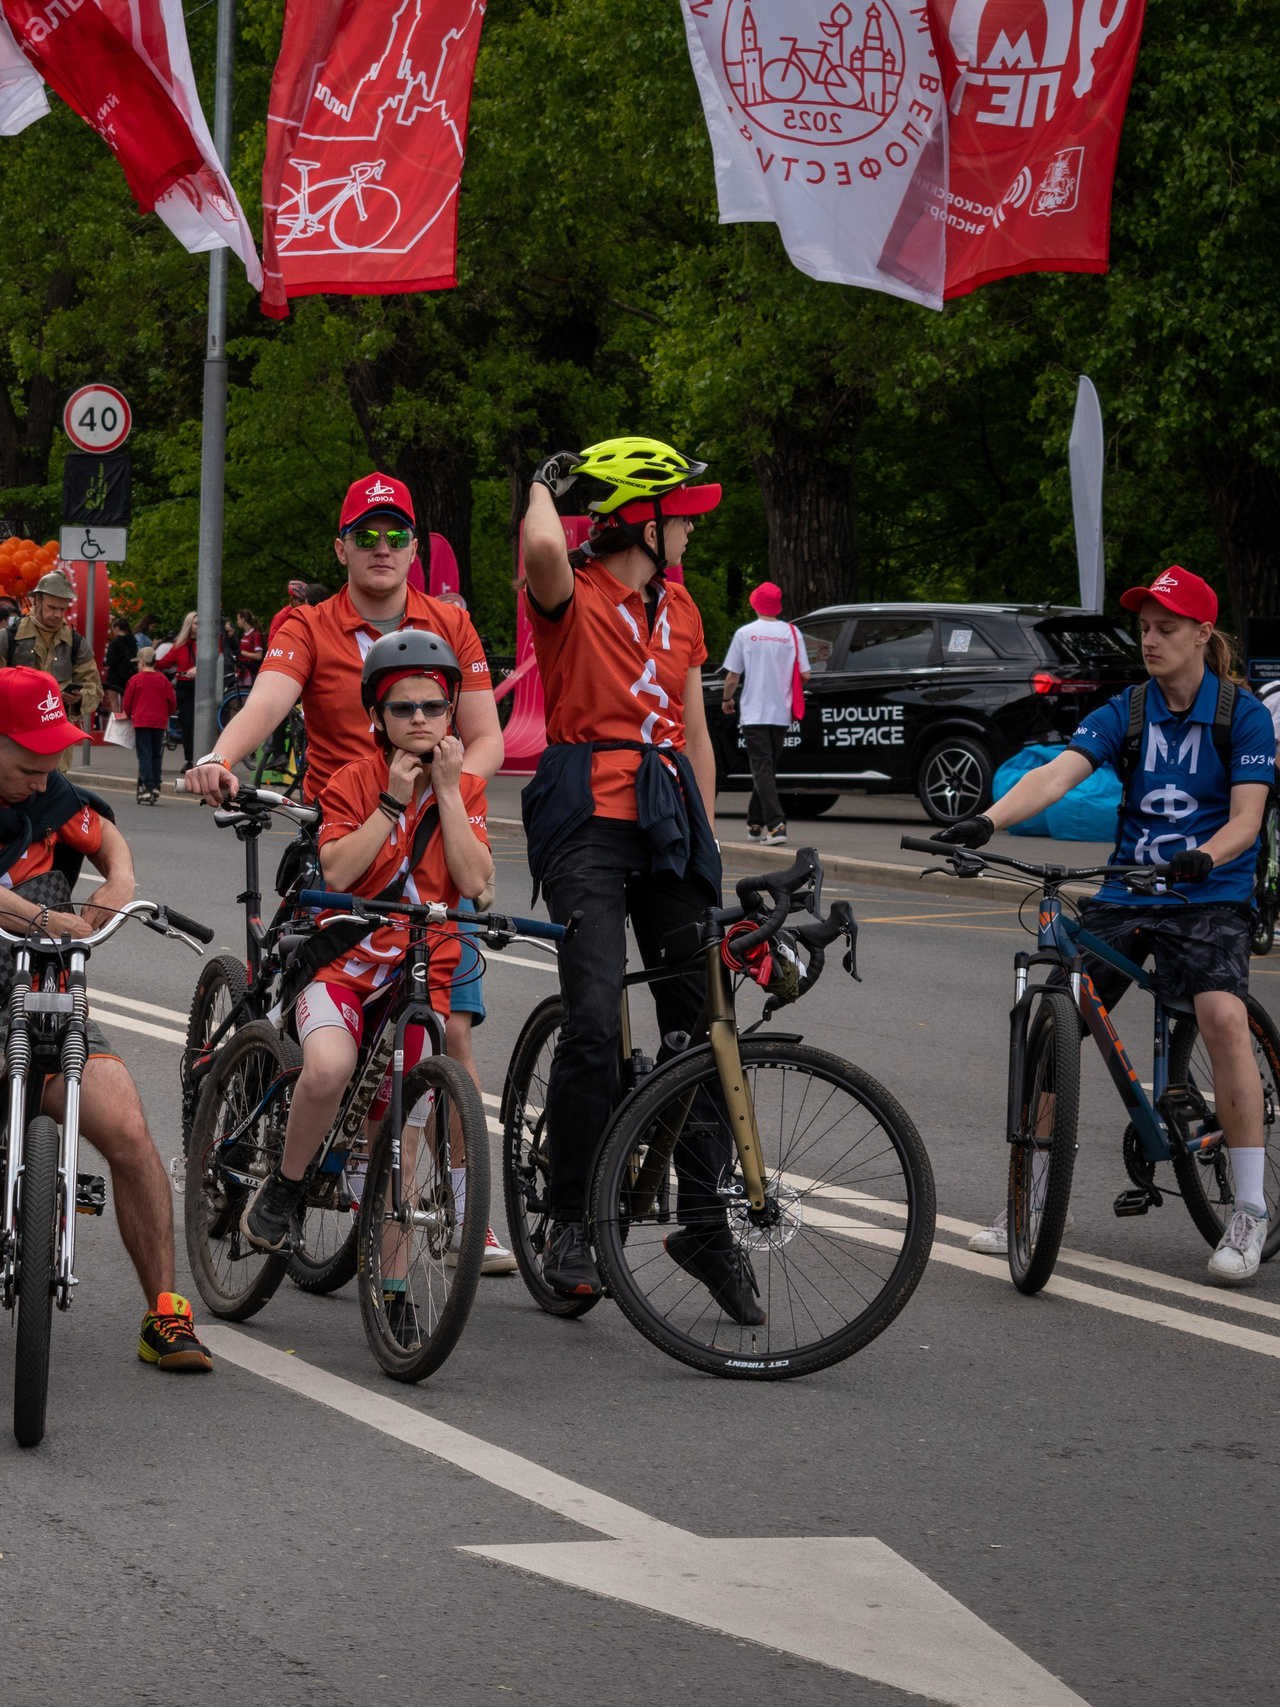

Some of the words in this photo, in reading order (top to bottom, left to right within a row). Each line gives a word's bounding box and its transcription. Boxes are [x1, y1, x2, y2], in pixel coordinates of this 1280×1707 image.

[78, 406, 118, 432] 40
[605, 476, 647, 489] ROCKRIDER
[367, 496, 394, 504] МФЮА
[41, 710, 64, 723] МФЮА
[821, 705, 904, 723] EVOLUTE
[822, 726, 905, 747] i-SPACE
[342, 1038, 395, 1135] GIANT
[235, 1116, 252, 1137] GIANT
[725, 1360, 766, 1369] TIRENT
[768, 1359, 790, 1368] CST
